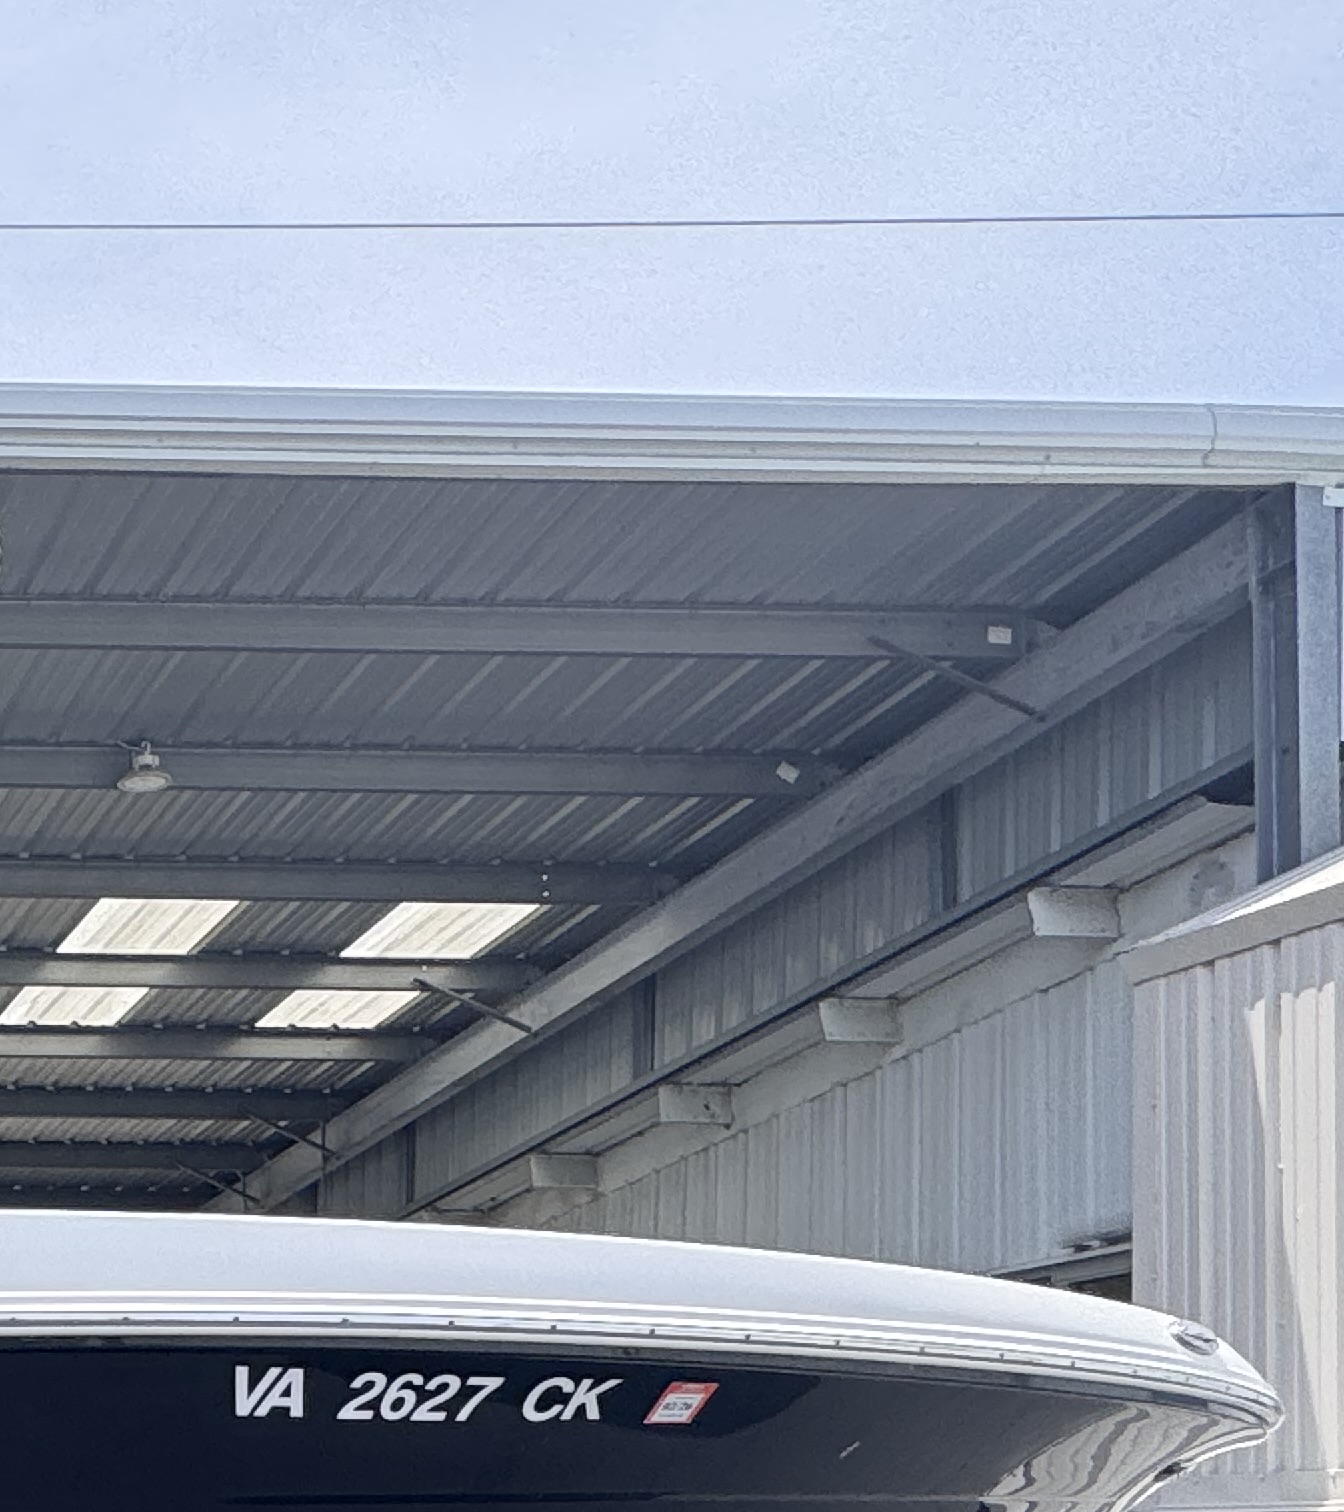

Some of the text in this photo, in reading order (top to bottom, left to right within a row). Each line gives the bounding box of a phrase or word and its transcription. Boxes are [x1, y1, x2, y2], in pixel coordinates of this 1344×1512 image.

[234, 1364, 623, 1422] VA 2627 CK
